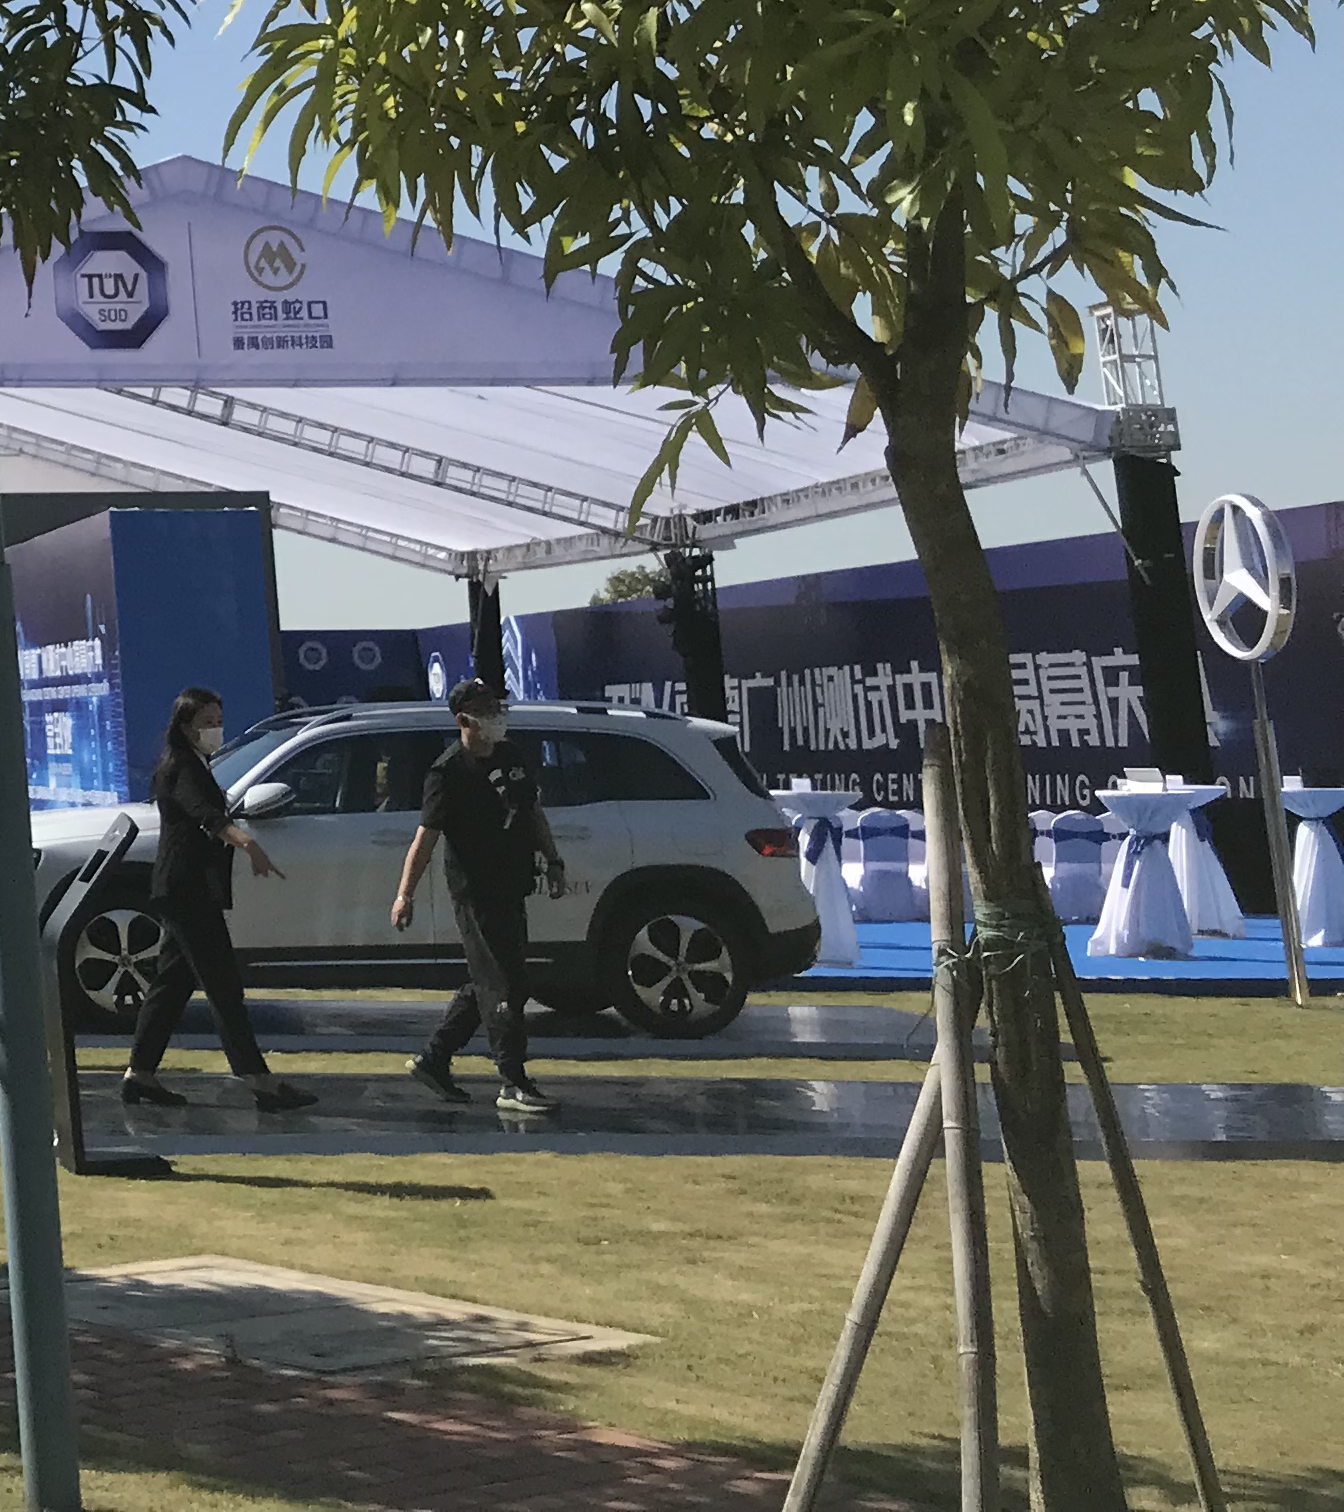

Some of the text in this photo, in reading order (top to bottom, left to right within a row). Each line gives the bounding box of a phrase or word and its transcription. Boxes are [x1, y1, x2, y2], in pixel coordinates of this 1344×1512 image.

[80, 272, 140, 299] TÜV
[97, 307, 128, 323] SÜD
[231, 298, 328, 322] 招商蛇口
